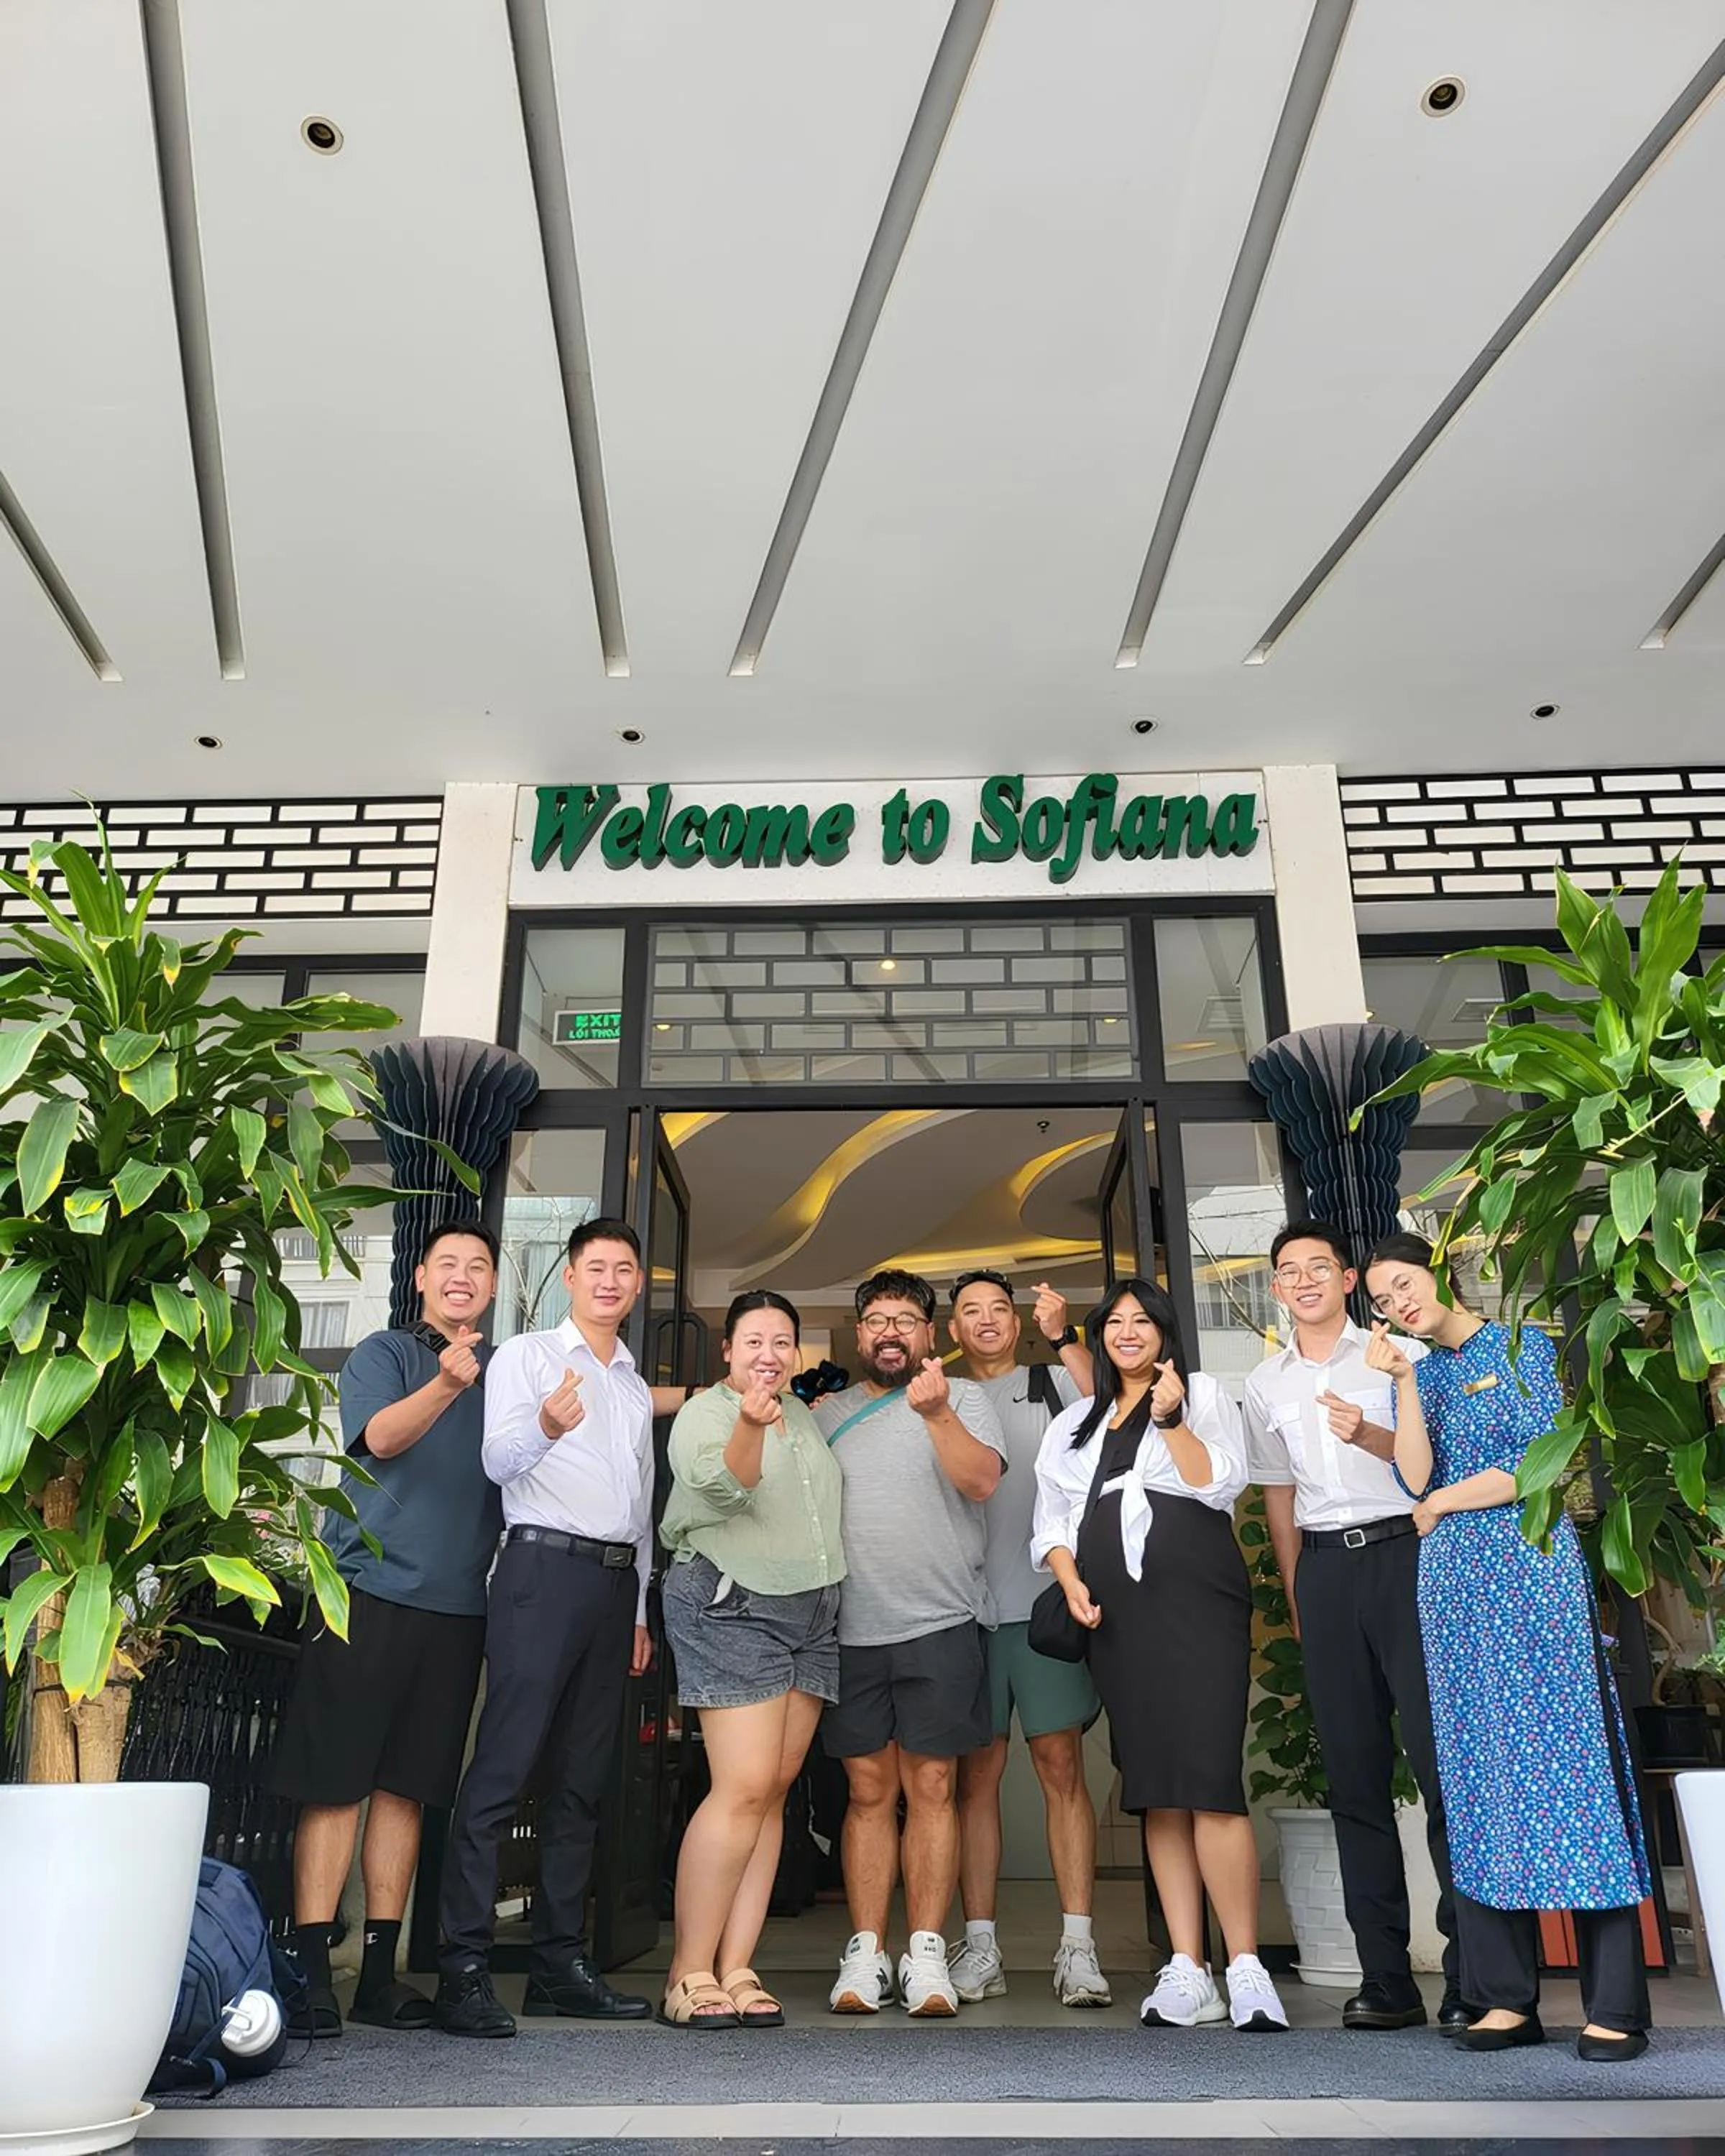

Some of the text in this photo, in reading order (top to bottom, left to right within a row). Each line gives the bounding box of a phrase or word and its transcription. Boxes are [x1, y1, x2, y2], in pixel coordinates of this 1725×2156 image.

[531, 773, 1260, 884] Welcome to Sofiana
[576, 1014, 621, 1027] EXIT
